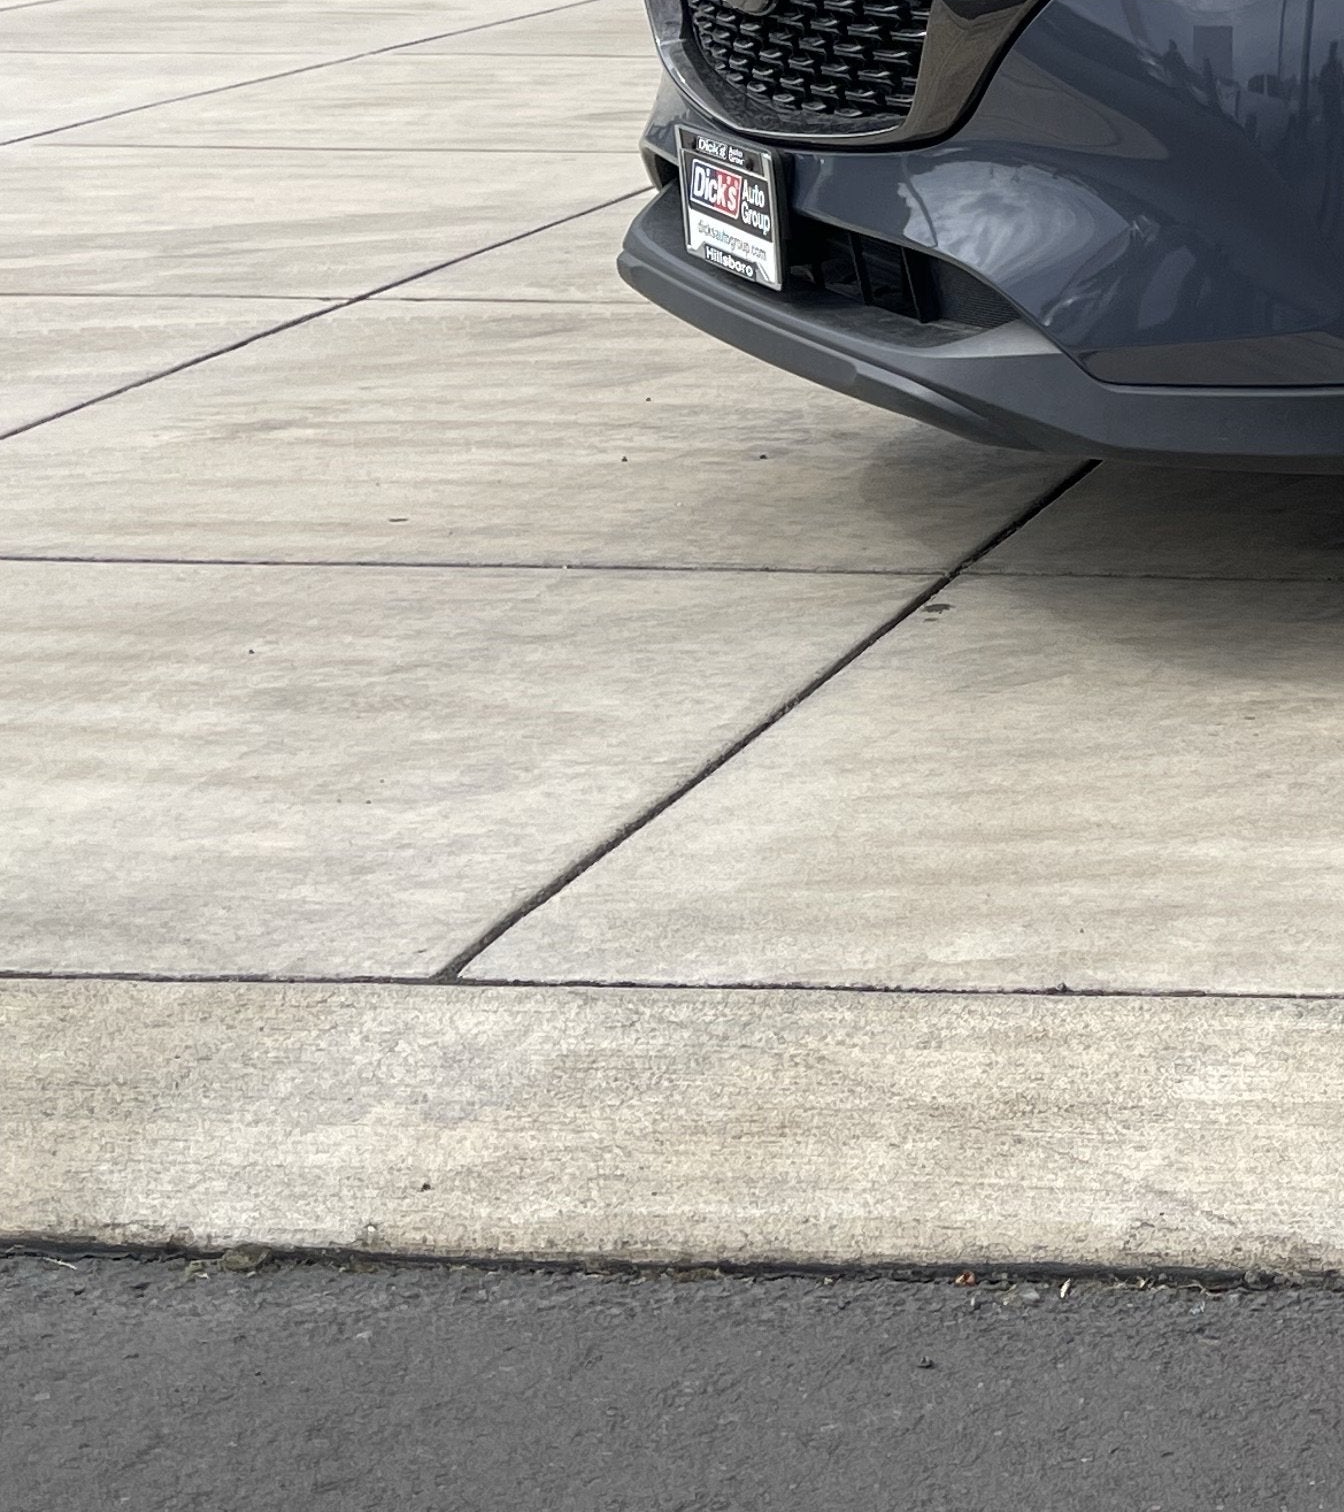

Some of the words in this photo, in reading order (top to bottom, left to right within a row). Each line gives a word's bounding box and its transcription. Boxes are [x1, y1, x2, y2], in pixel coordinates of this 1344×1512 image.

[694, 166, 739, 212] Dick's
[742, 180, 765, 208] Auto
[741, 202, 771, 235] Group
[706, 245, 754, 277] Hillsboro
